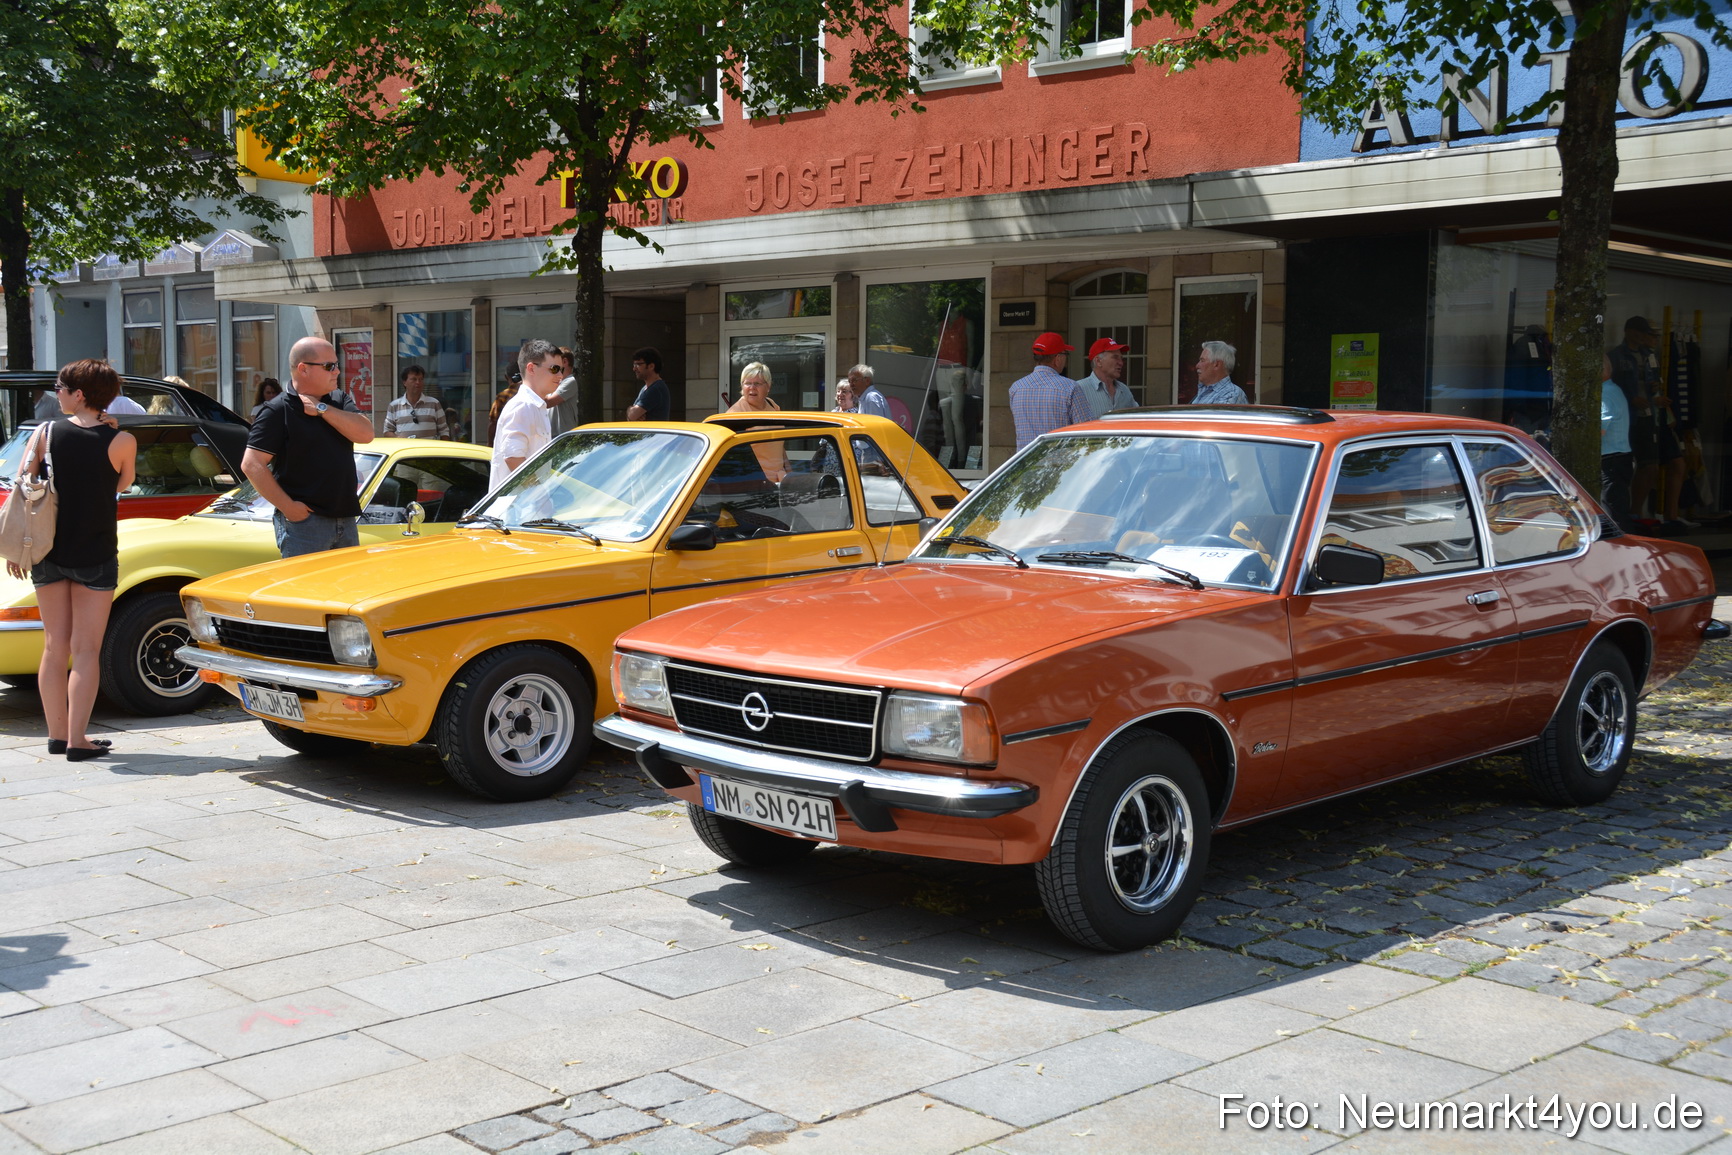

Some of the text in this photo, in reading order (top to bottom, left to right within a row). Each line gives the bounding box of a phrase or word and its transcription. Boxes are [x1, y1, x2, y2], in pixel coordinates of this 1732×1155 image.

[552, 156, 685, 209] TKO
[745, 122, 1151, 212] JOSEF ZEININGER
[393, 205, 455, 247] JOH.
[1199, 551, 1229, 559] 193
[266, 692, 284, 716] JM
[282, 696, 303, 719] 3H
[712, 781, 742, 814] NM
[754, 791, 784, 823] SN
